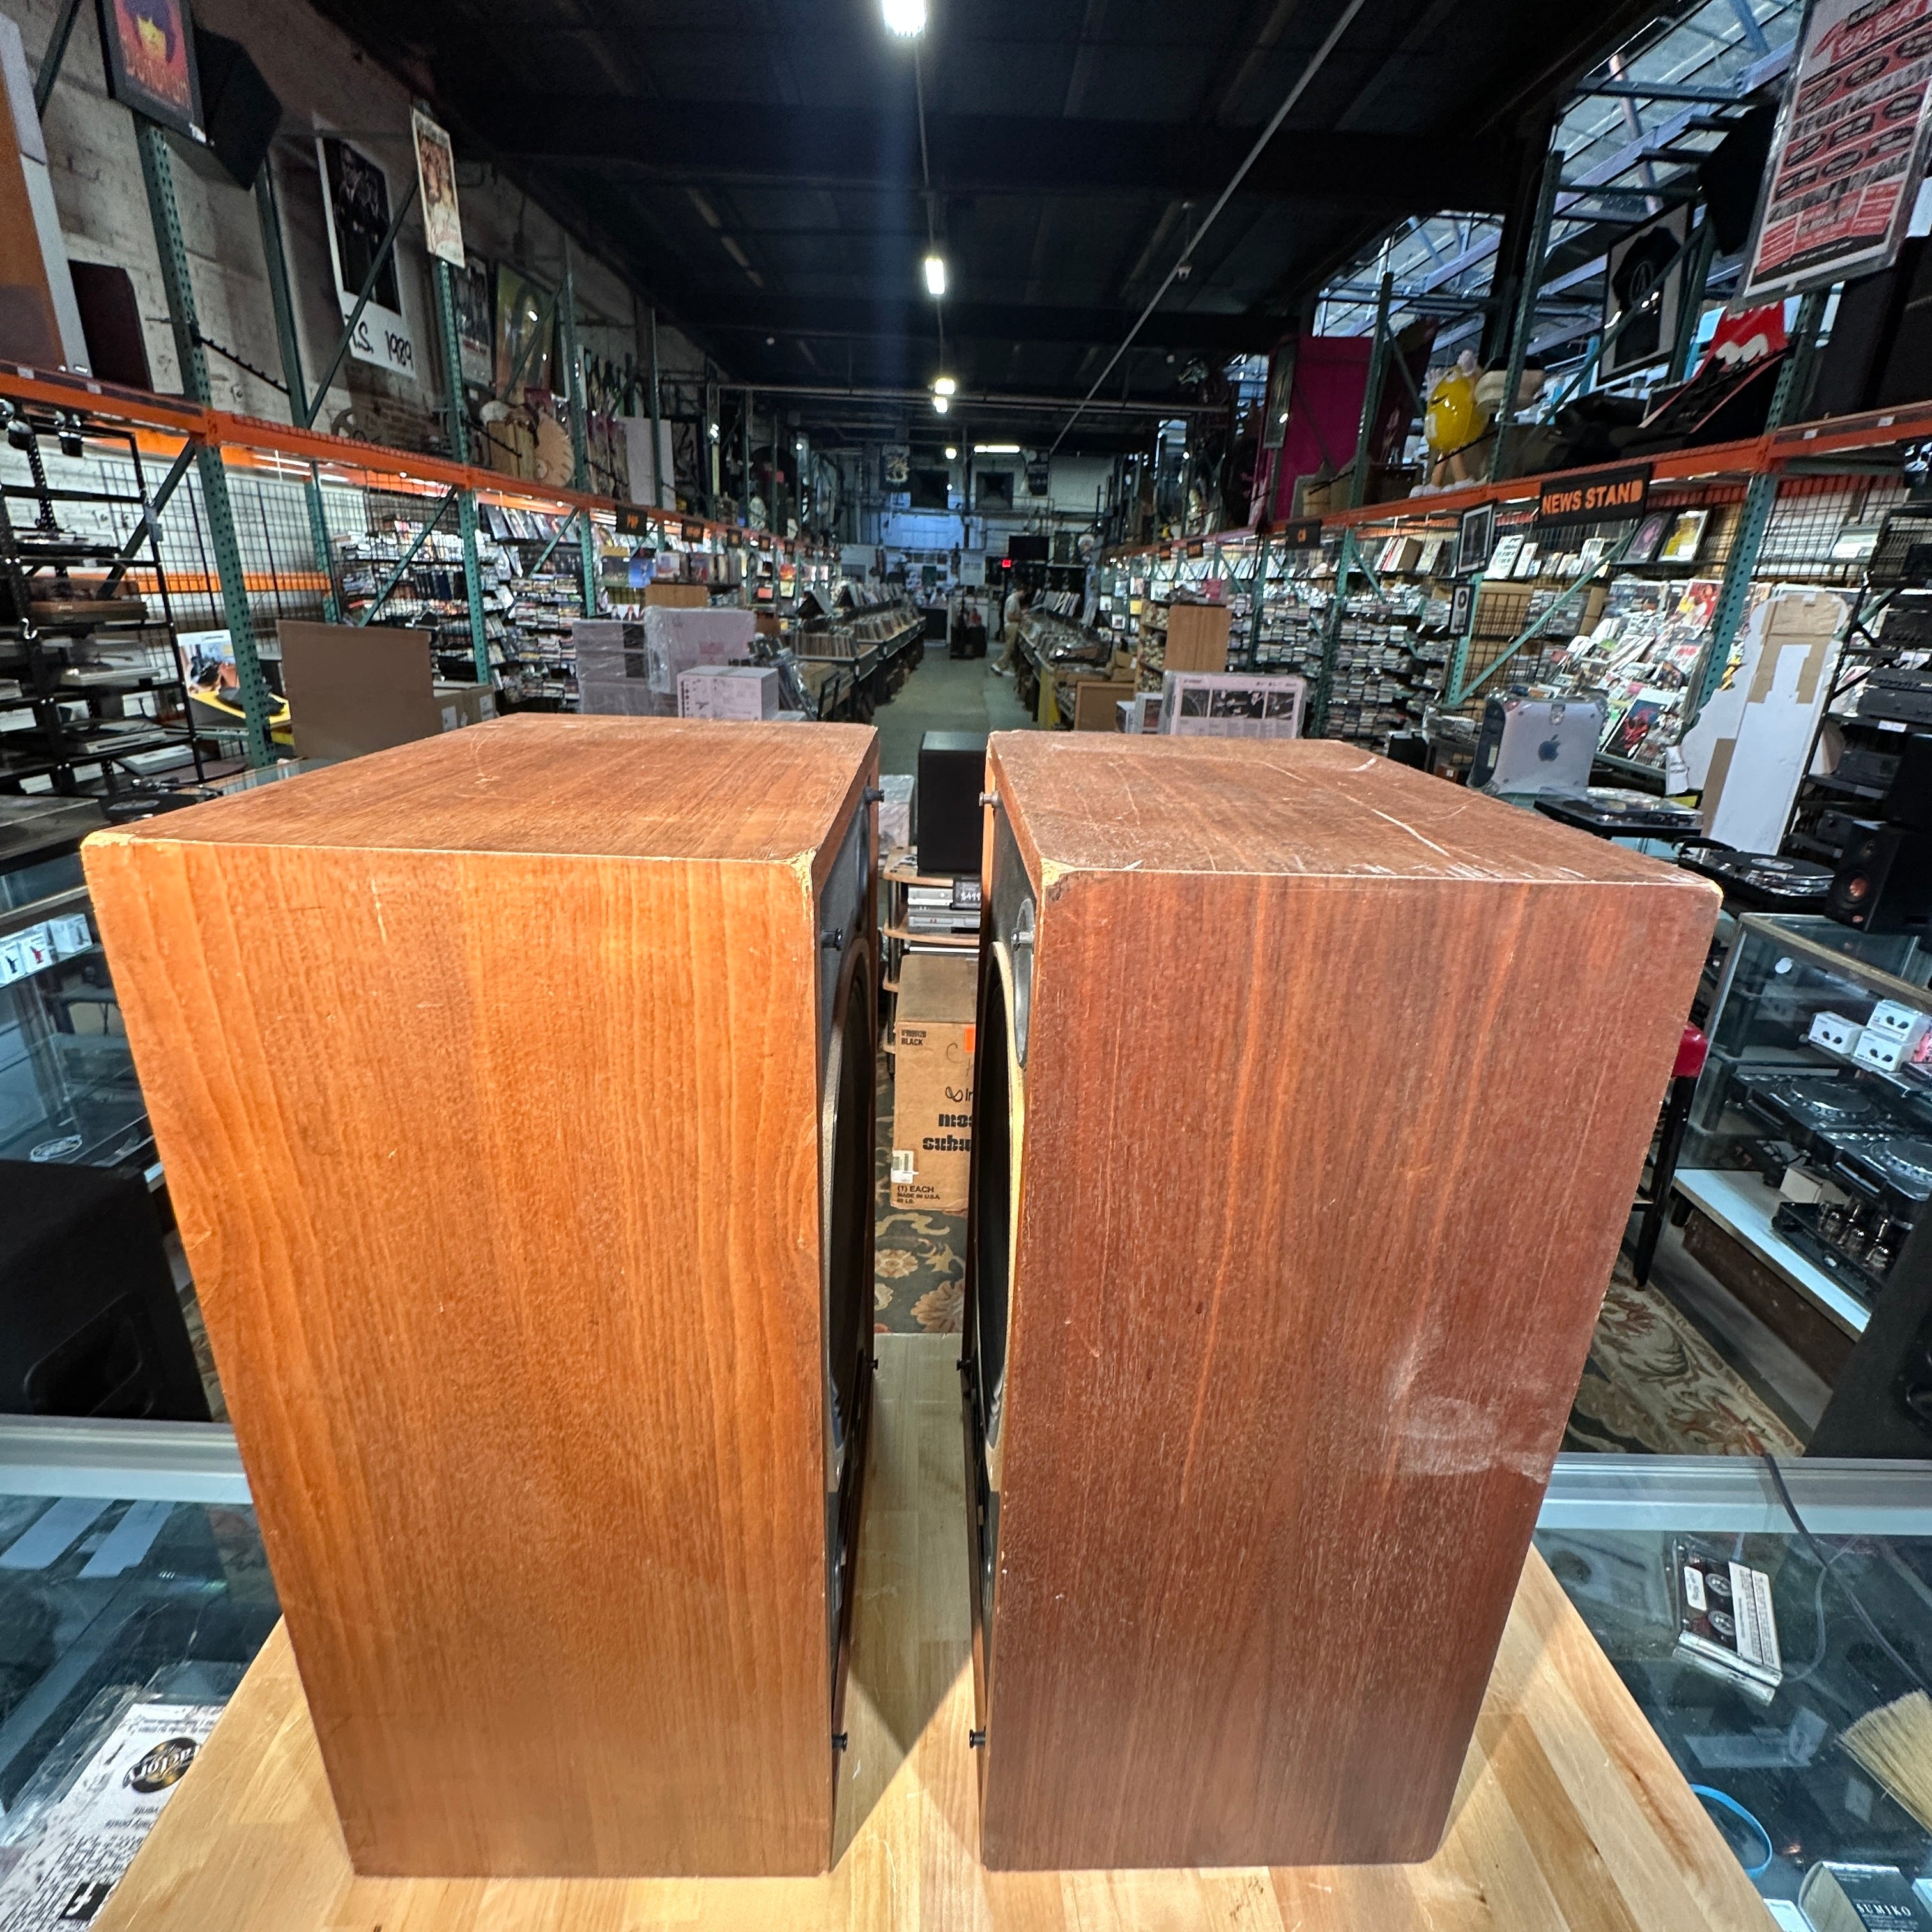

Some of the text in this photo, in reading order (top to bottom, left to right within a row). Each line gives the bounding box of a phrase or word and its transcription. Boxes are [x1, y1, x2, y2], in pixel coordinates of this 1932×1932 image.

[385, 330, 414, 369] 1989
[1542, 480, 1643, 516] NEWS STAND
[901, 1038, 923, 1046] BLACK
[132, 1805, 161, 1815] vents
[1856, 1903, 1912, 1917] SUMIKO
